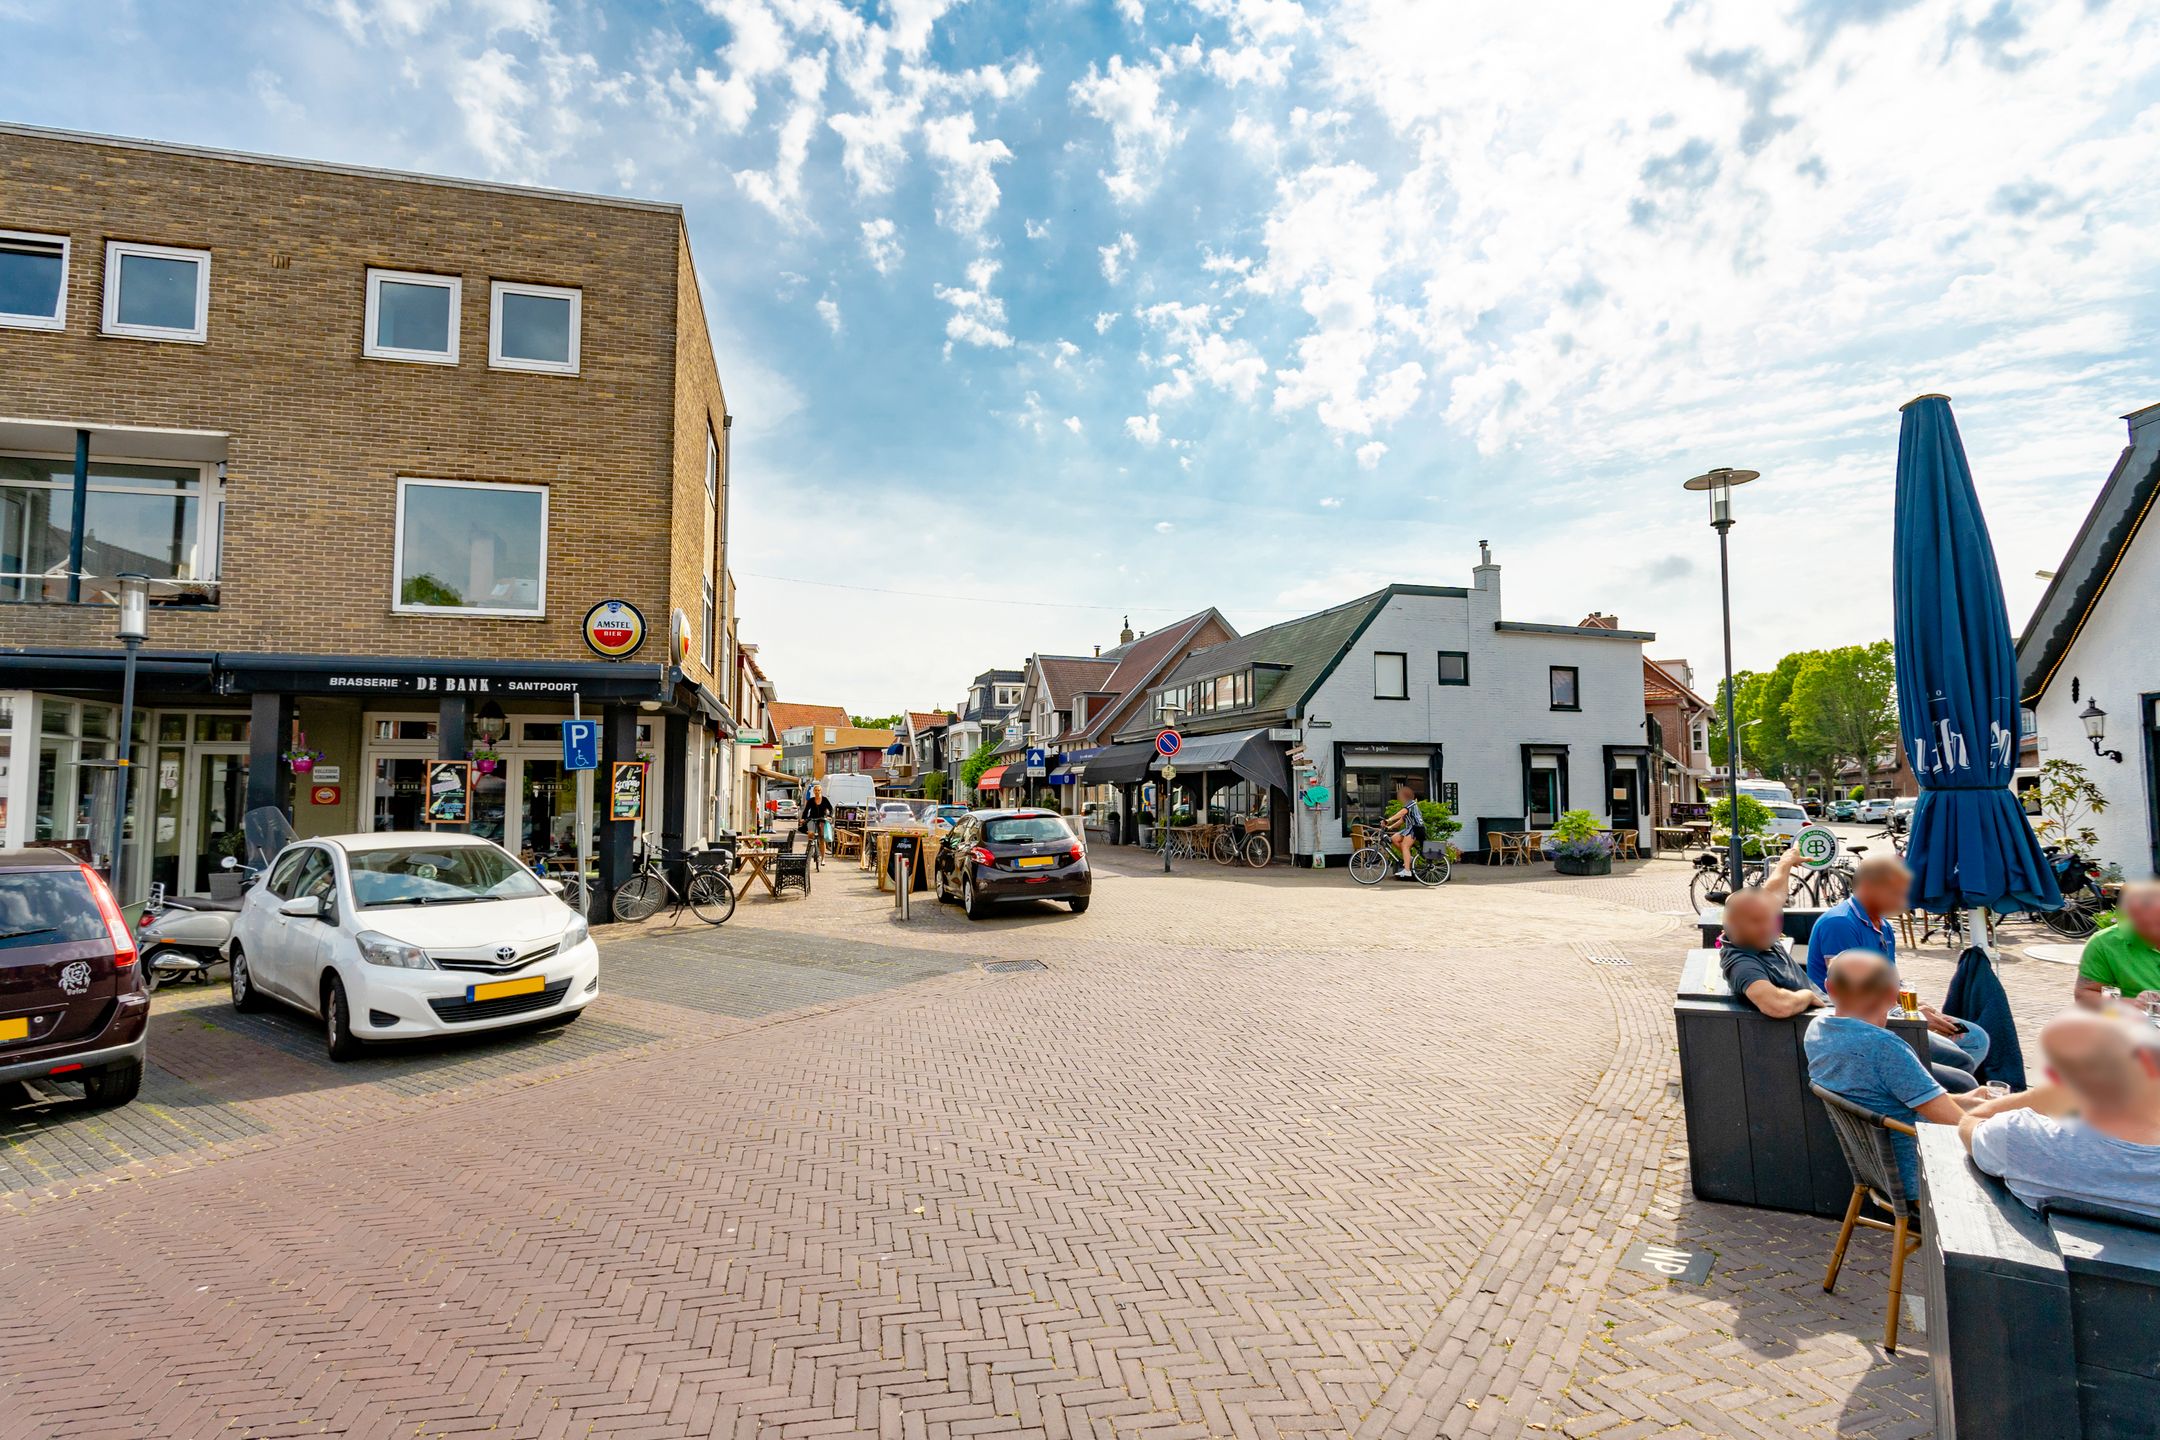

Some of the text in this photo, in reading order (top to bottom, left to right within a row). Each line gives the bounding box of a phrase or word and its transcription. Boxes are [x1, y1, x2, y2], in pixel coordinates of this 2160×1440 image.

[597, 621, 630, 629] AMSTEL
[329, 677, 578, 692] BRASSERIE DE BANK SANTPOORT
[571, 724, 589, 749] P
